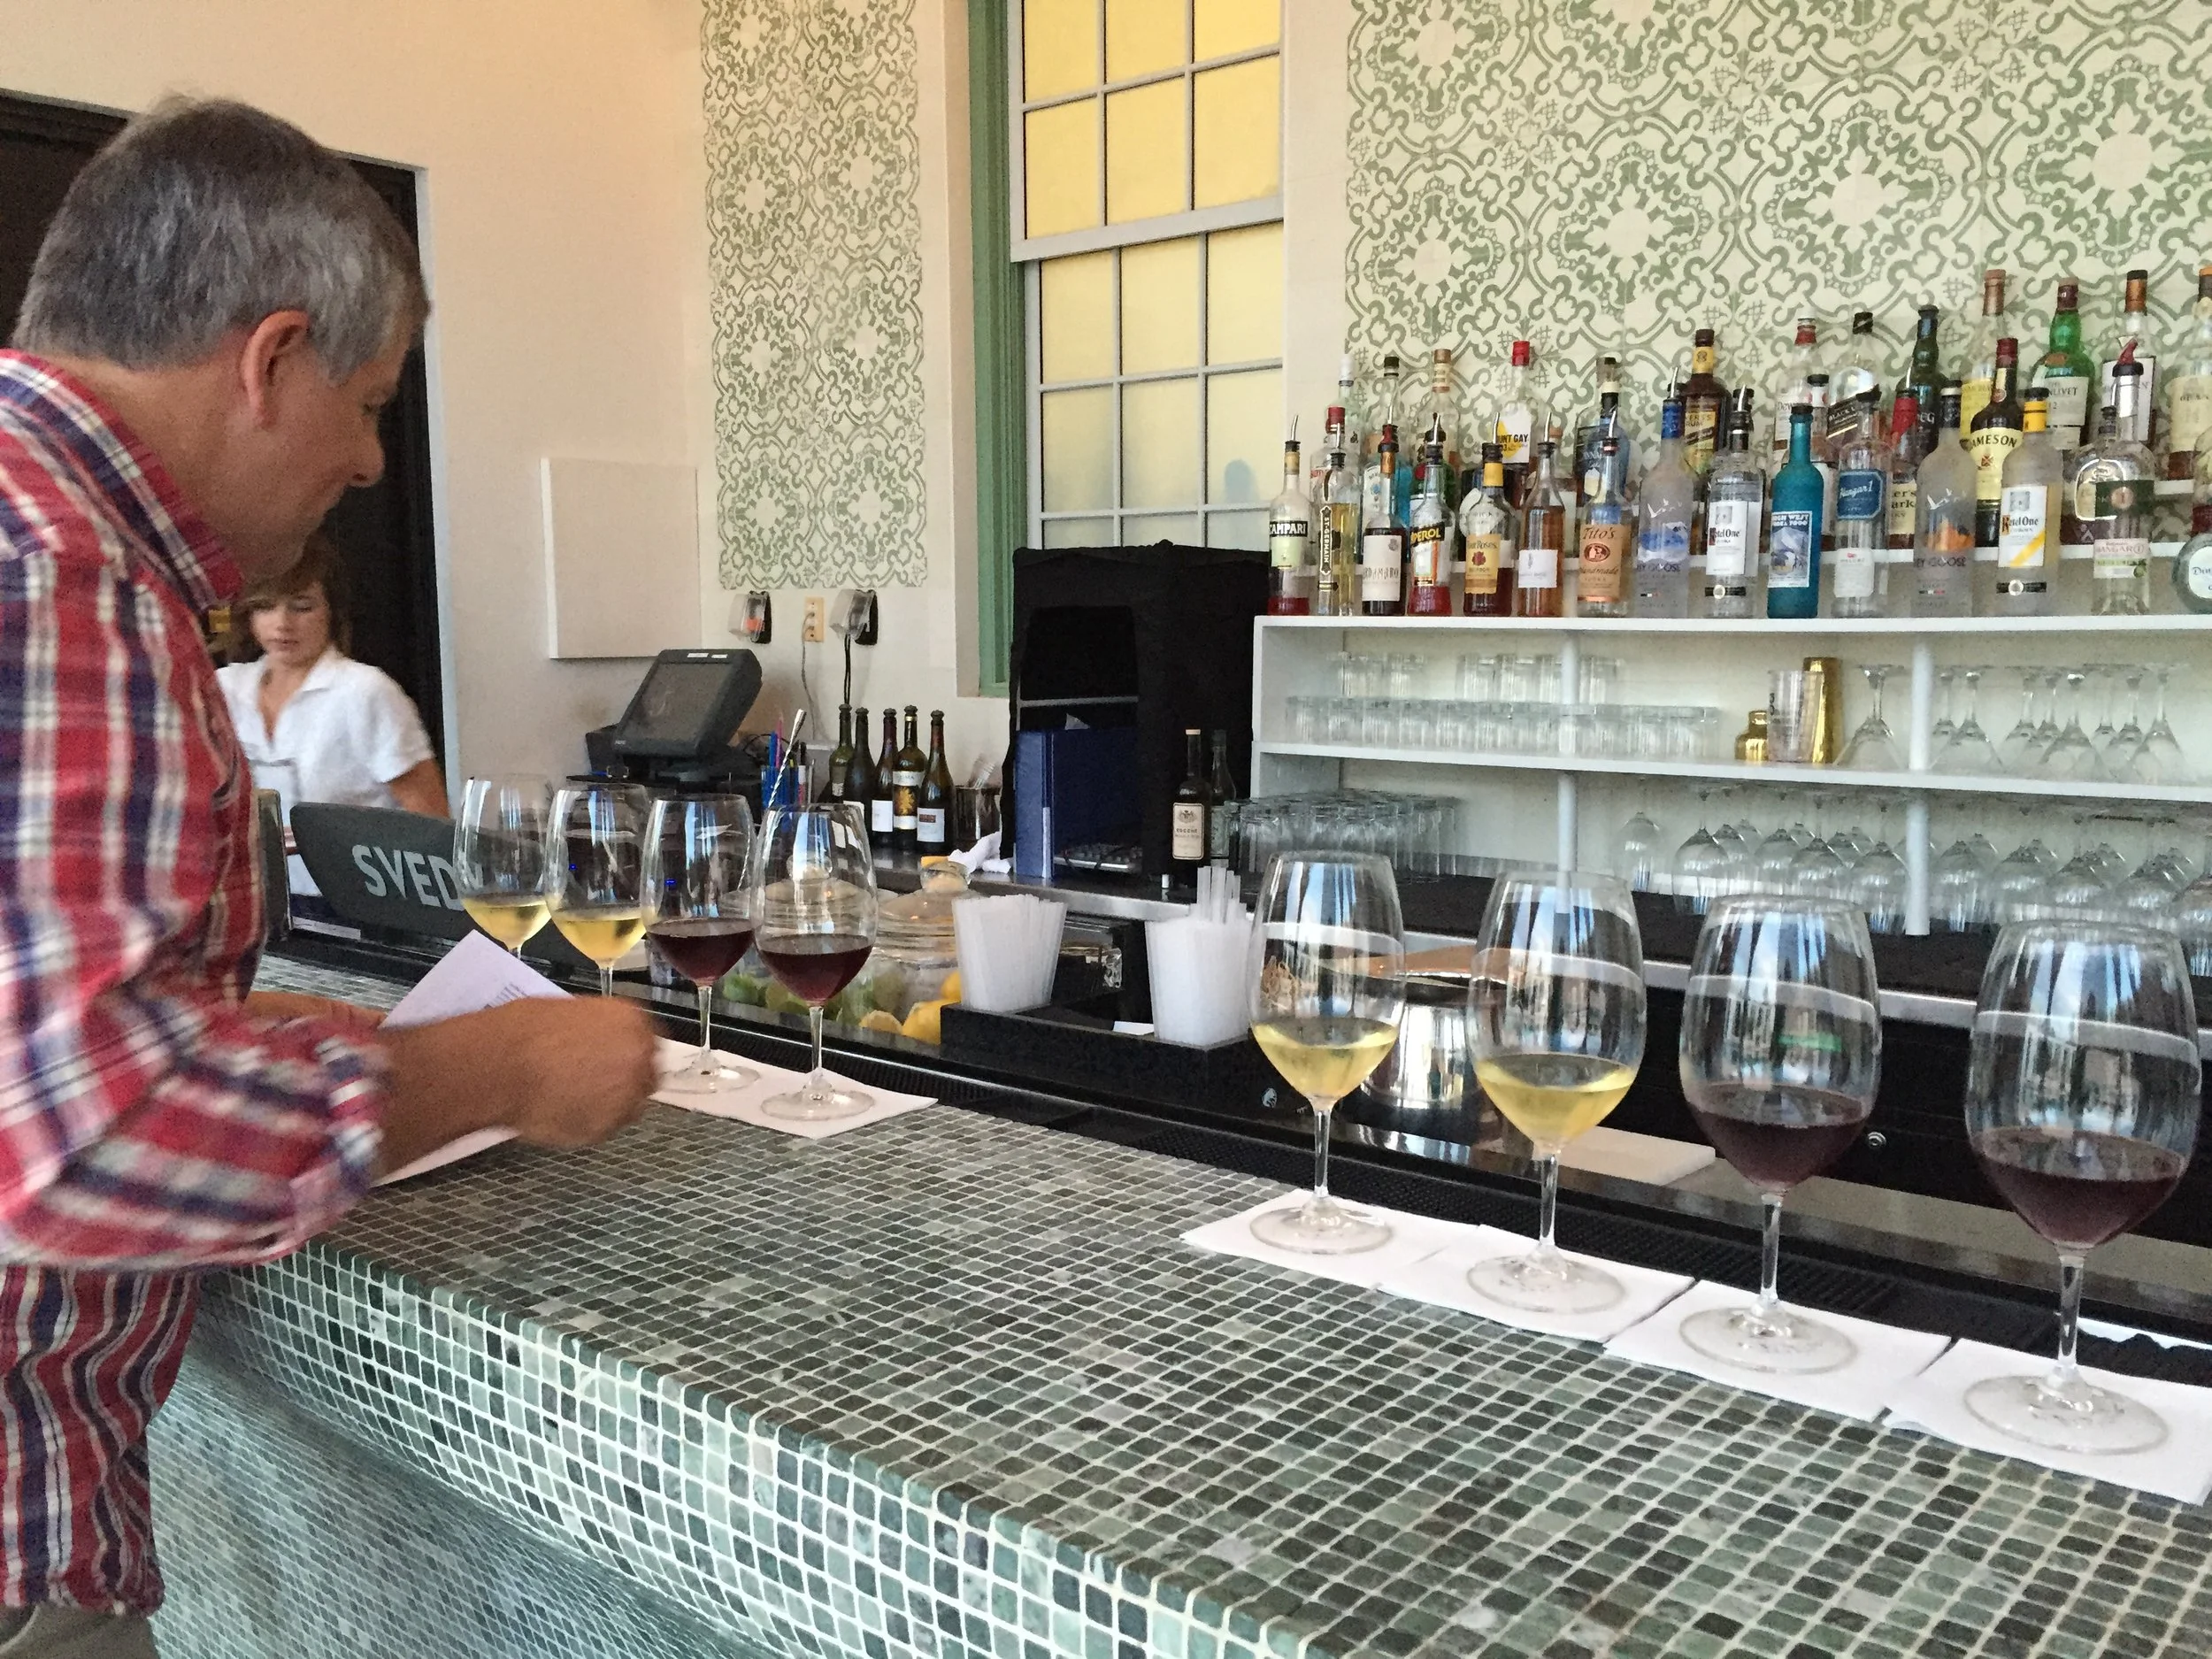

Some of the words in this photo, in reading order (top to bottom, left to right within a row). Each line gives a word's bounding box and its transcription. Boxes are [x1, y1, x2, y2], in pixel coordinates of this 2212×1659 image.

[2047, 386, 2078, 396] NLIVET
[1496, 434, 1512, 443] UNT
[1513, 434, 1529, 443] GAY
[1968, 434, 2017, 451] AMESON
[1891, 499, 1915, 509] ark
[2022, 516, 2039, 526] One
[1583, 526, 1617, 540] Tito's
[1928, 557, 1966, 567] GOOSE
[352, 844, 483, 911] SVED
